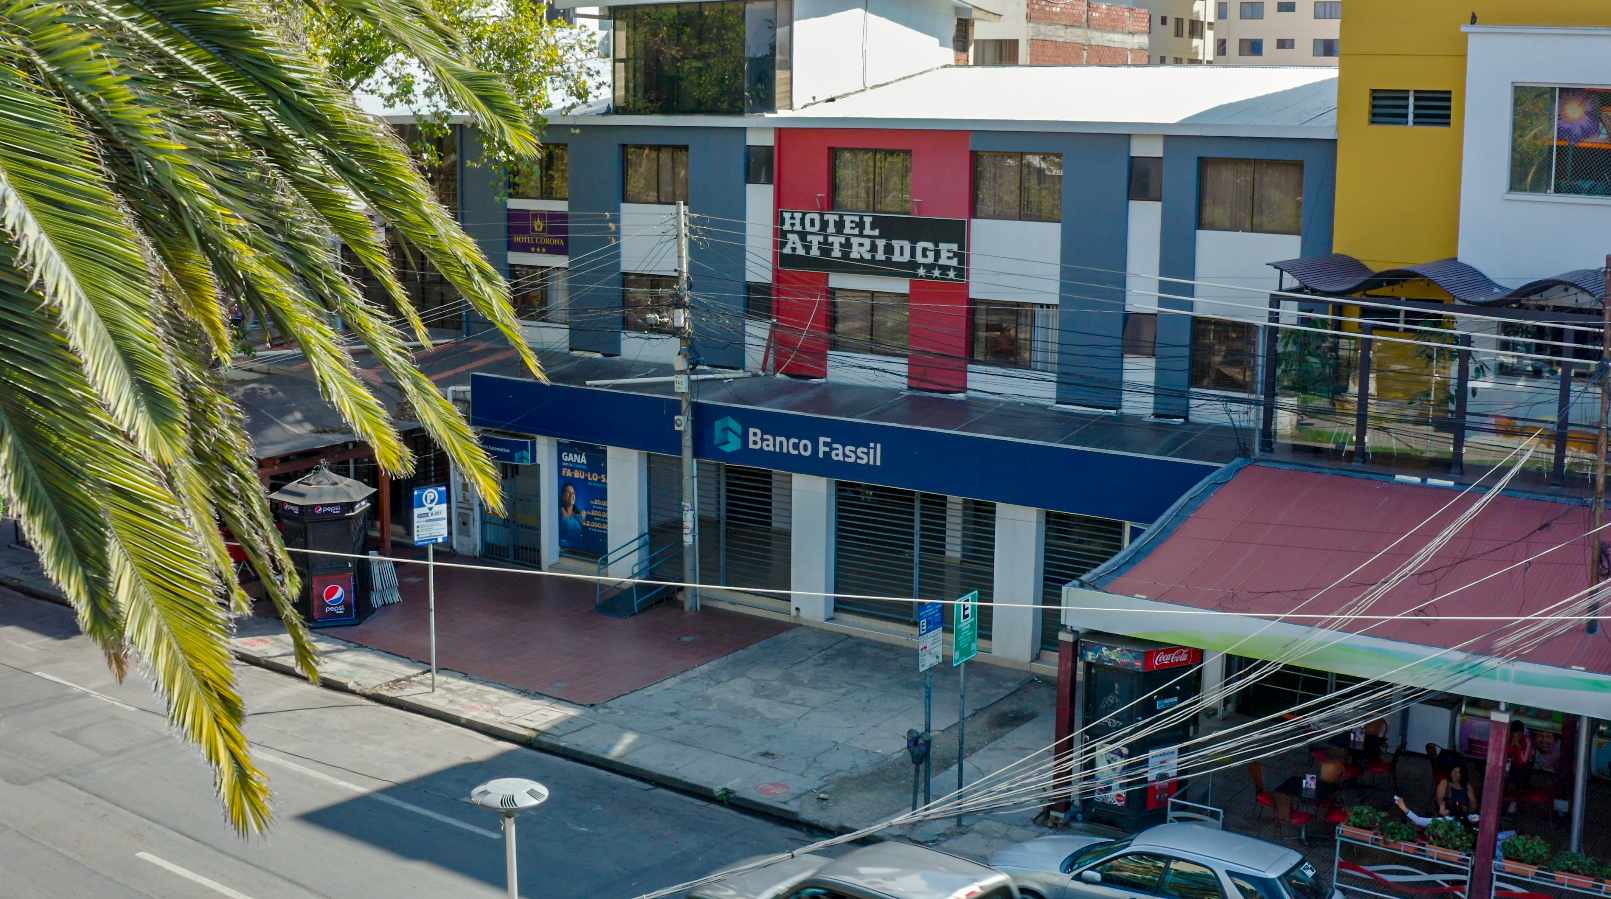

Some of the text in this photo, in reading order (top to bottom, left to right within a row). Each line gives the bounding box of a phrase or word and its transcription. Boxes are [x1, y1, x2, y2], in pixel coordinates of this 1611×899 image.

[782, 212, 880, 236] HOTEL
[513, 235, 535, 244] HOTEL
[782, 233, 959, 267] ATTRIDGE
[562, 451, 587, 465] GANÁ
[748, 427, 882, 466] Banco Fassil
